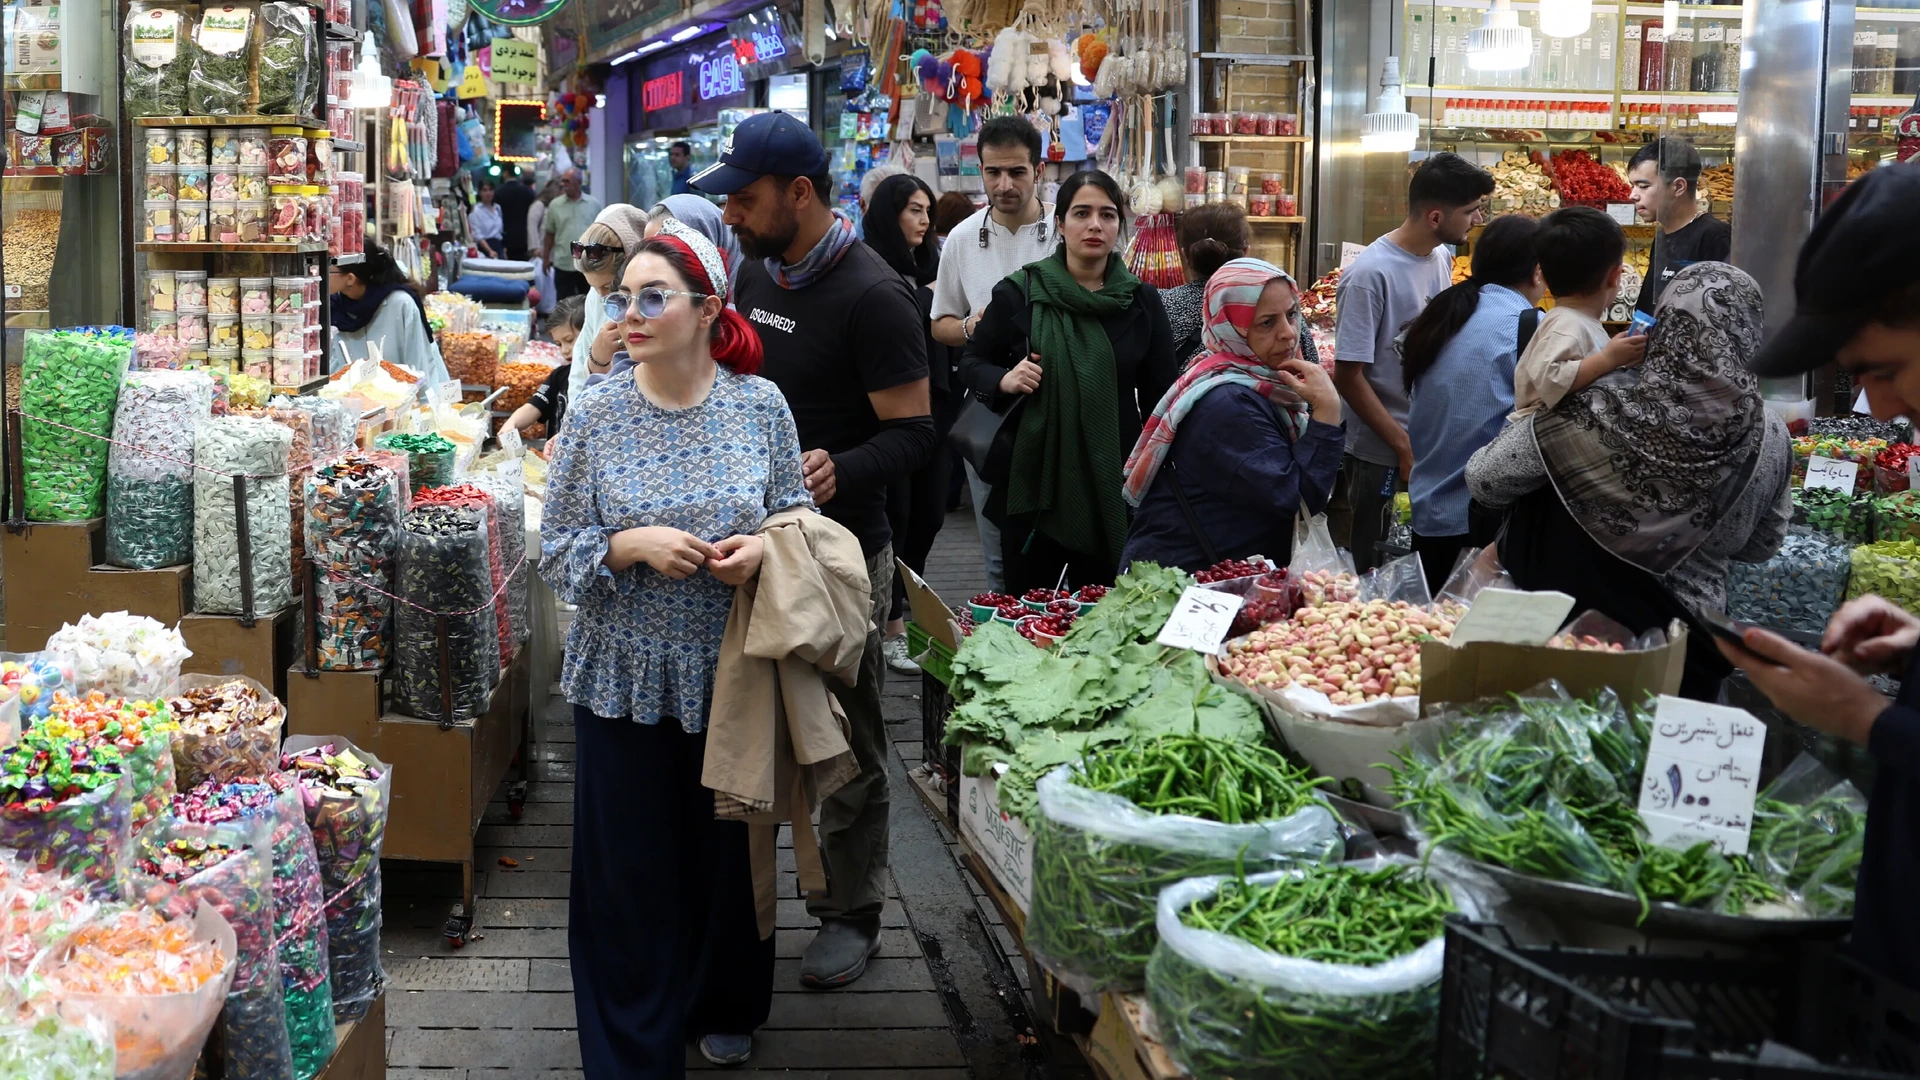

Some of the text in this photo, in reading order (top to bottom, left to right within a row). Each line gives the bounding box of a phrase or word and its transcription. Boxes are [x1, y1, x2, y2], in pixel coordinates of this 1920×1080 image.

[495, 46, 517, 59] یزدی
[491, 64, 537, 82] موجود است
[749, 307, 796, 334] DSQUARED2
[1659, 717, 1755, 749] فلفل شیرین
[985, 805, 1026, 866] MAJESTIC
[1003, 853, 1028, 888] Brand
